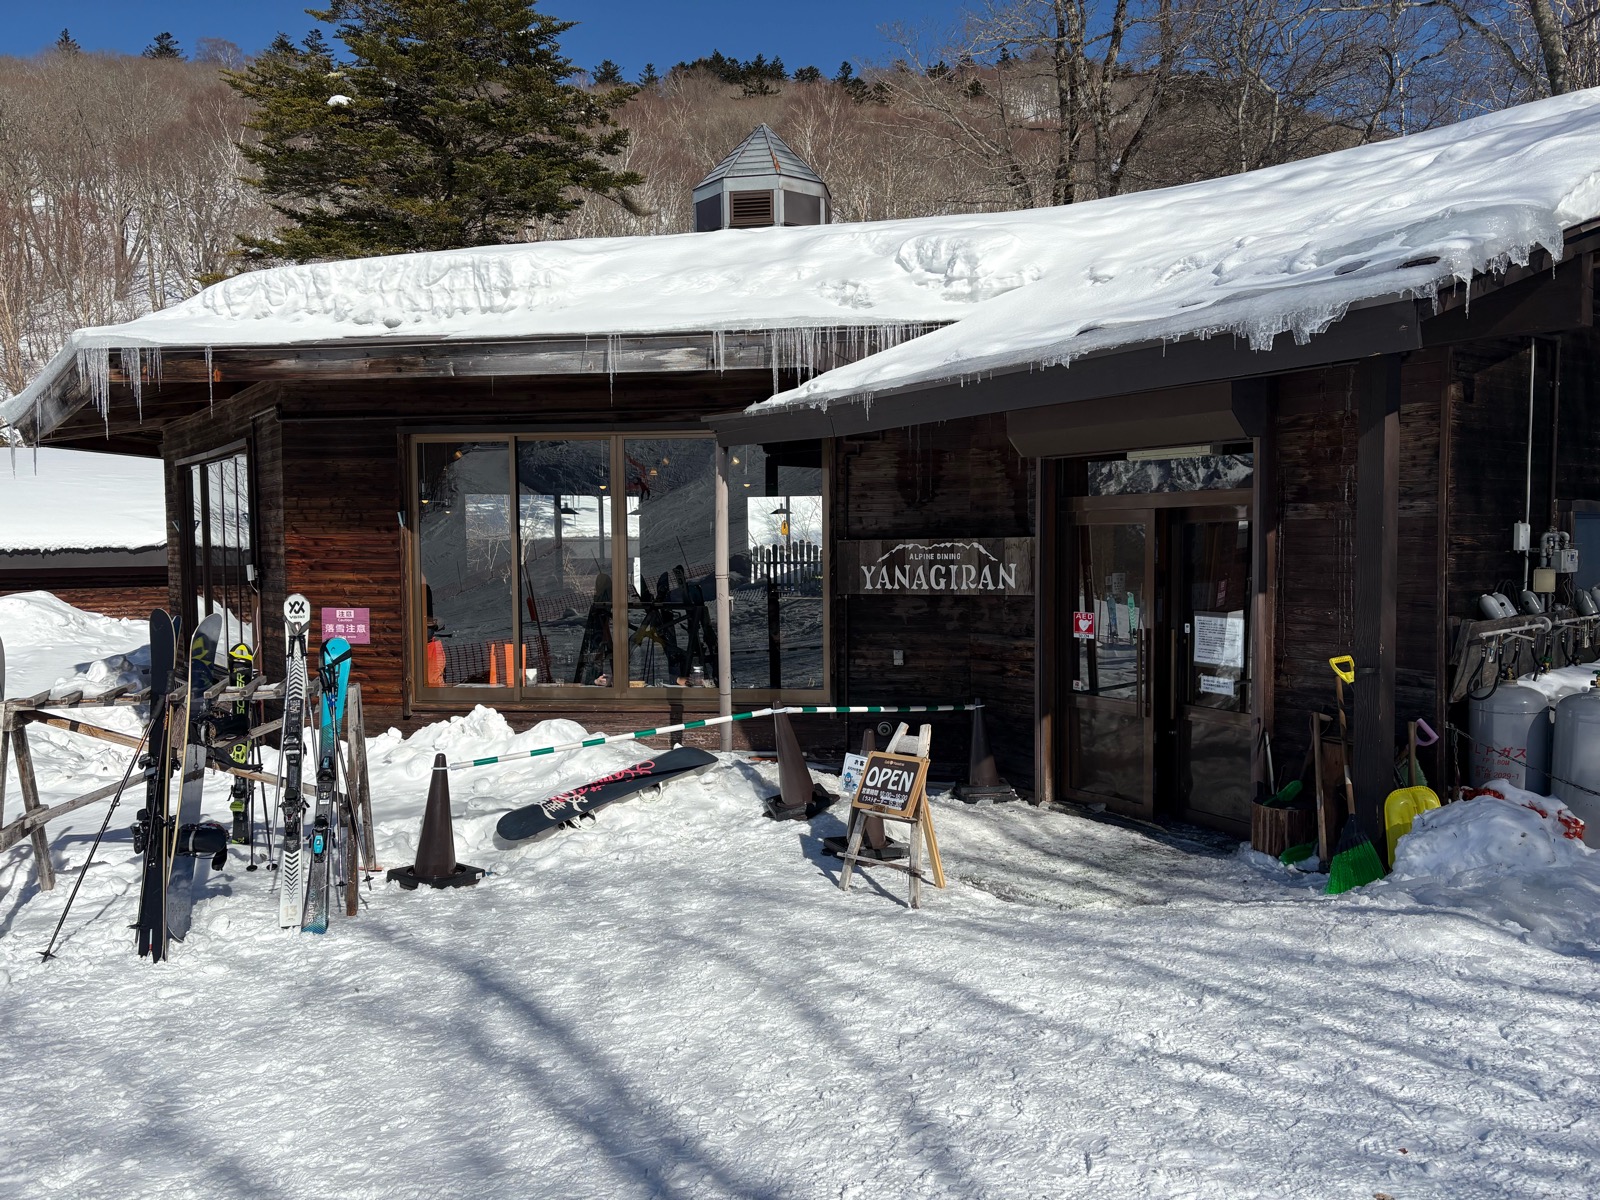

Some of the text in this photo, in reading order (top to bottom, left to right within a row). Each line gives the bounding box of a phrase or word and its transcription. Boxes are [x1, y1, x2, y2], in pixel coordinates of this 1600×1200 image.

[861, 563, 1017, 590] YANAGIRAN
[325, 624, 366, 633] 落雪注意
[865, 766, 914, 792] OPEN
[1493, 771, 1519, 779] 2029-1
